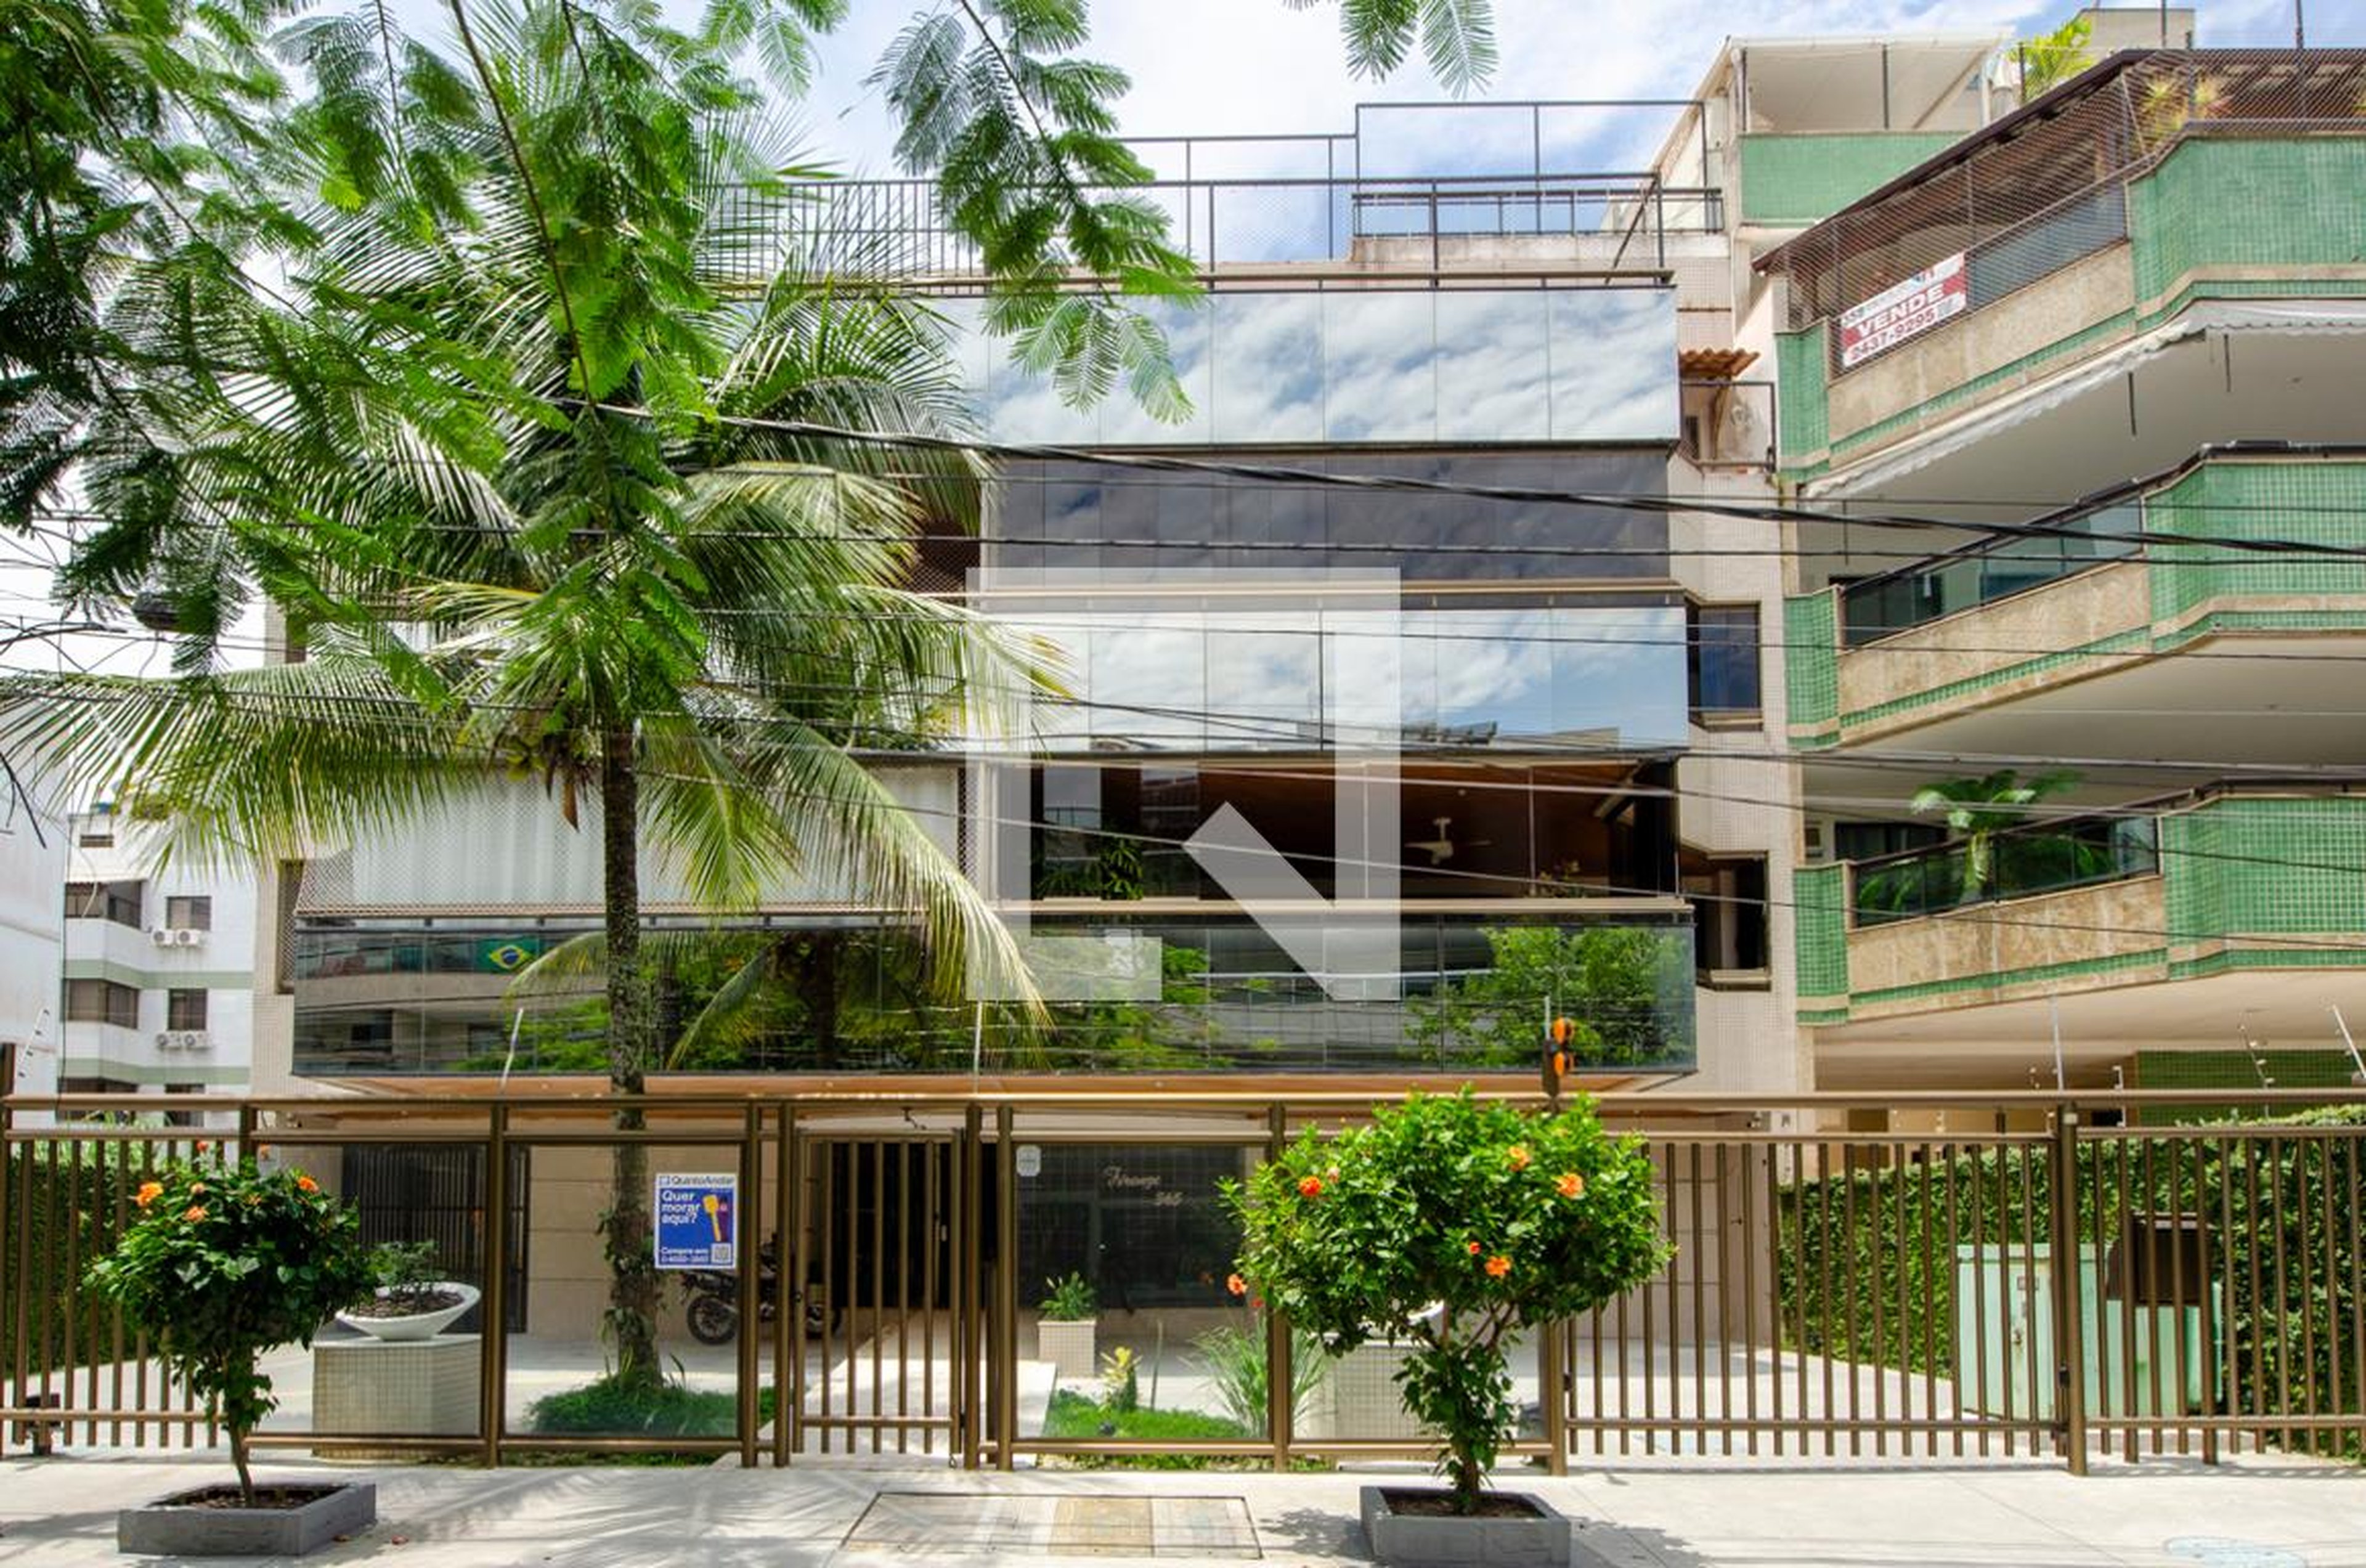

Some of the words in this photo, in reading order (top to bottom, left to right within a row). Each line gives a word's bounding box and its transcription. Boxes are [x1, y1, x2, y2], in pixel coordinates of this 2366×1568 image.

[1857, 283, 1945, 337] VENDE
[662, 1190, 695, 1201] Quer
[662, 1203, 701, 1213] morar
[662, 1213, 697, 1225] aqui?
